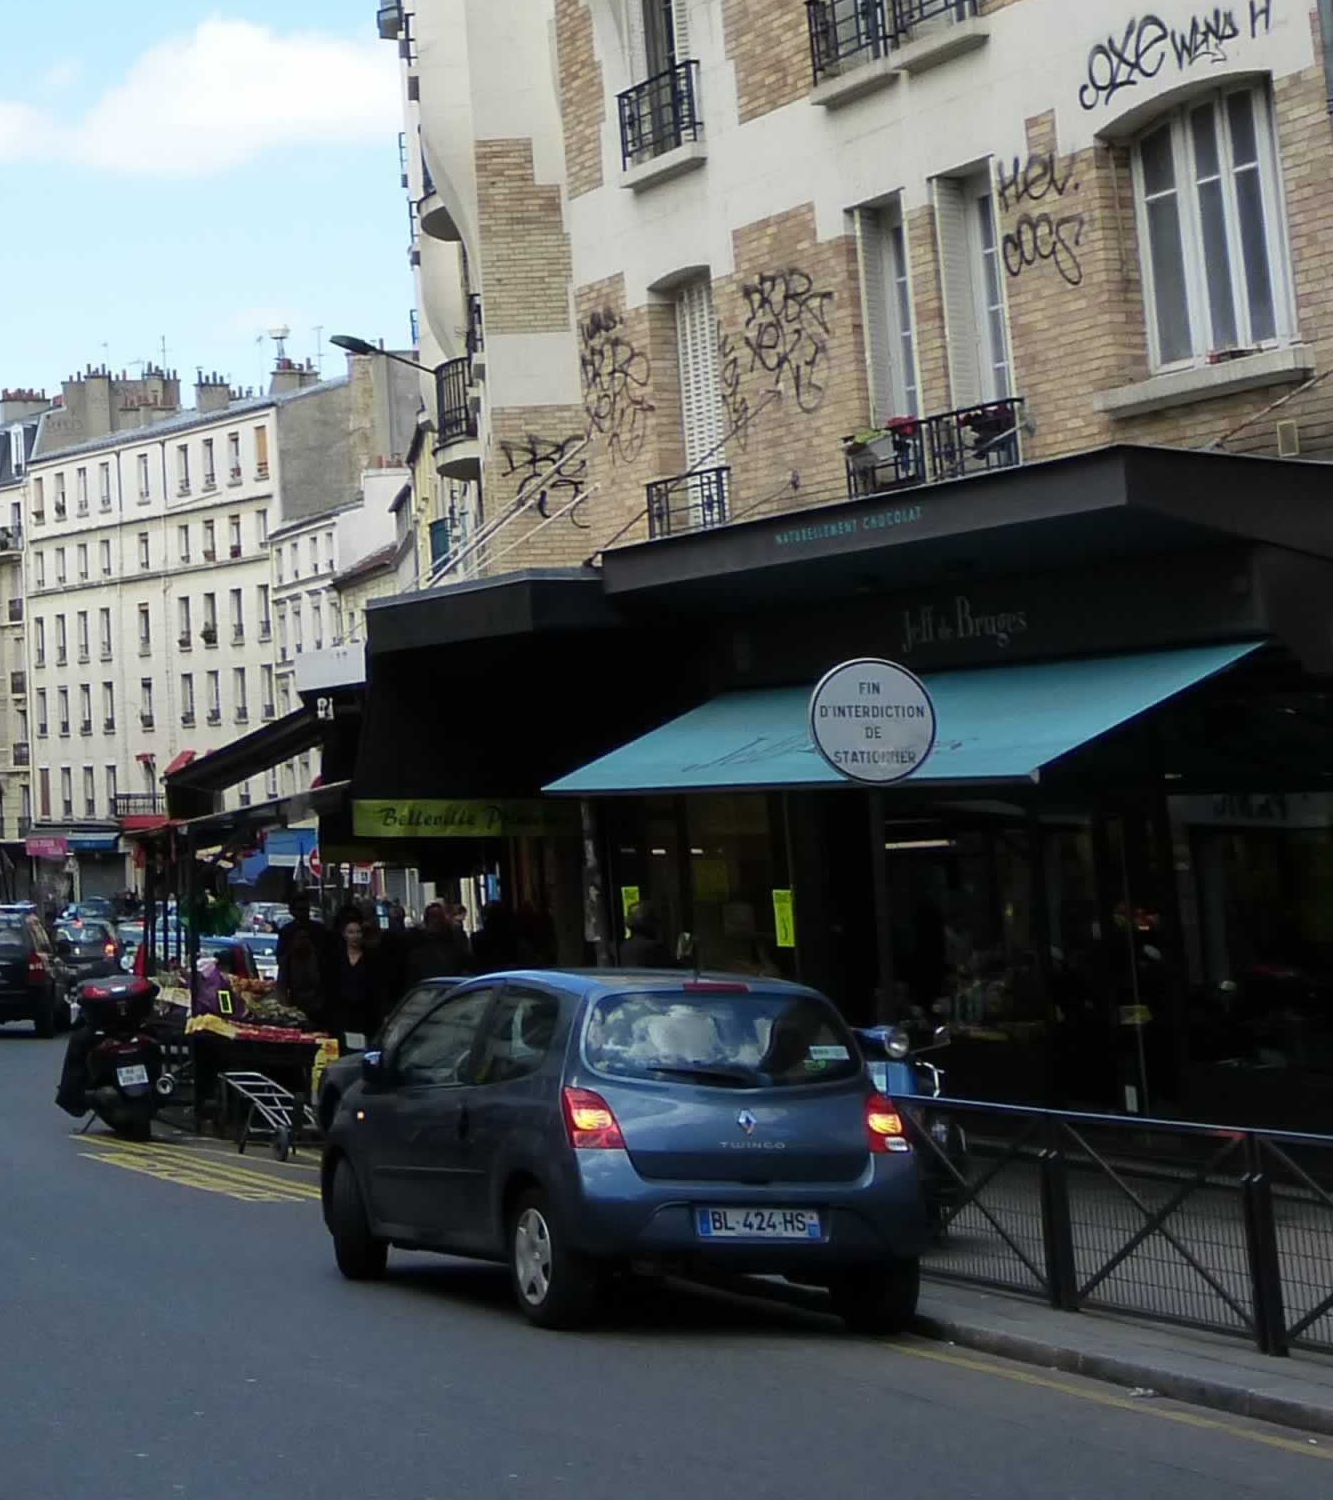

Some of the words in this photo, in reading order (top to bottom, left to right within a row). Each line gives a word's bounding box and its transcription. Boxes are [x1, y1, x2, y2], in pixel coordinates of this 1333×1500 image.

[862, 505, 923, 530] CHOCOLAT
[955, 595, 1030, 652] Bruges
[858, 681, 881, 695] FIN
[819, 704, 925, 718] D'INTERDICTION
[864, 726, 883, 740] DE
[378, 807, 476, 828] Belleville
[718, 1141, 786, 1149] TWINGO
